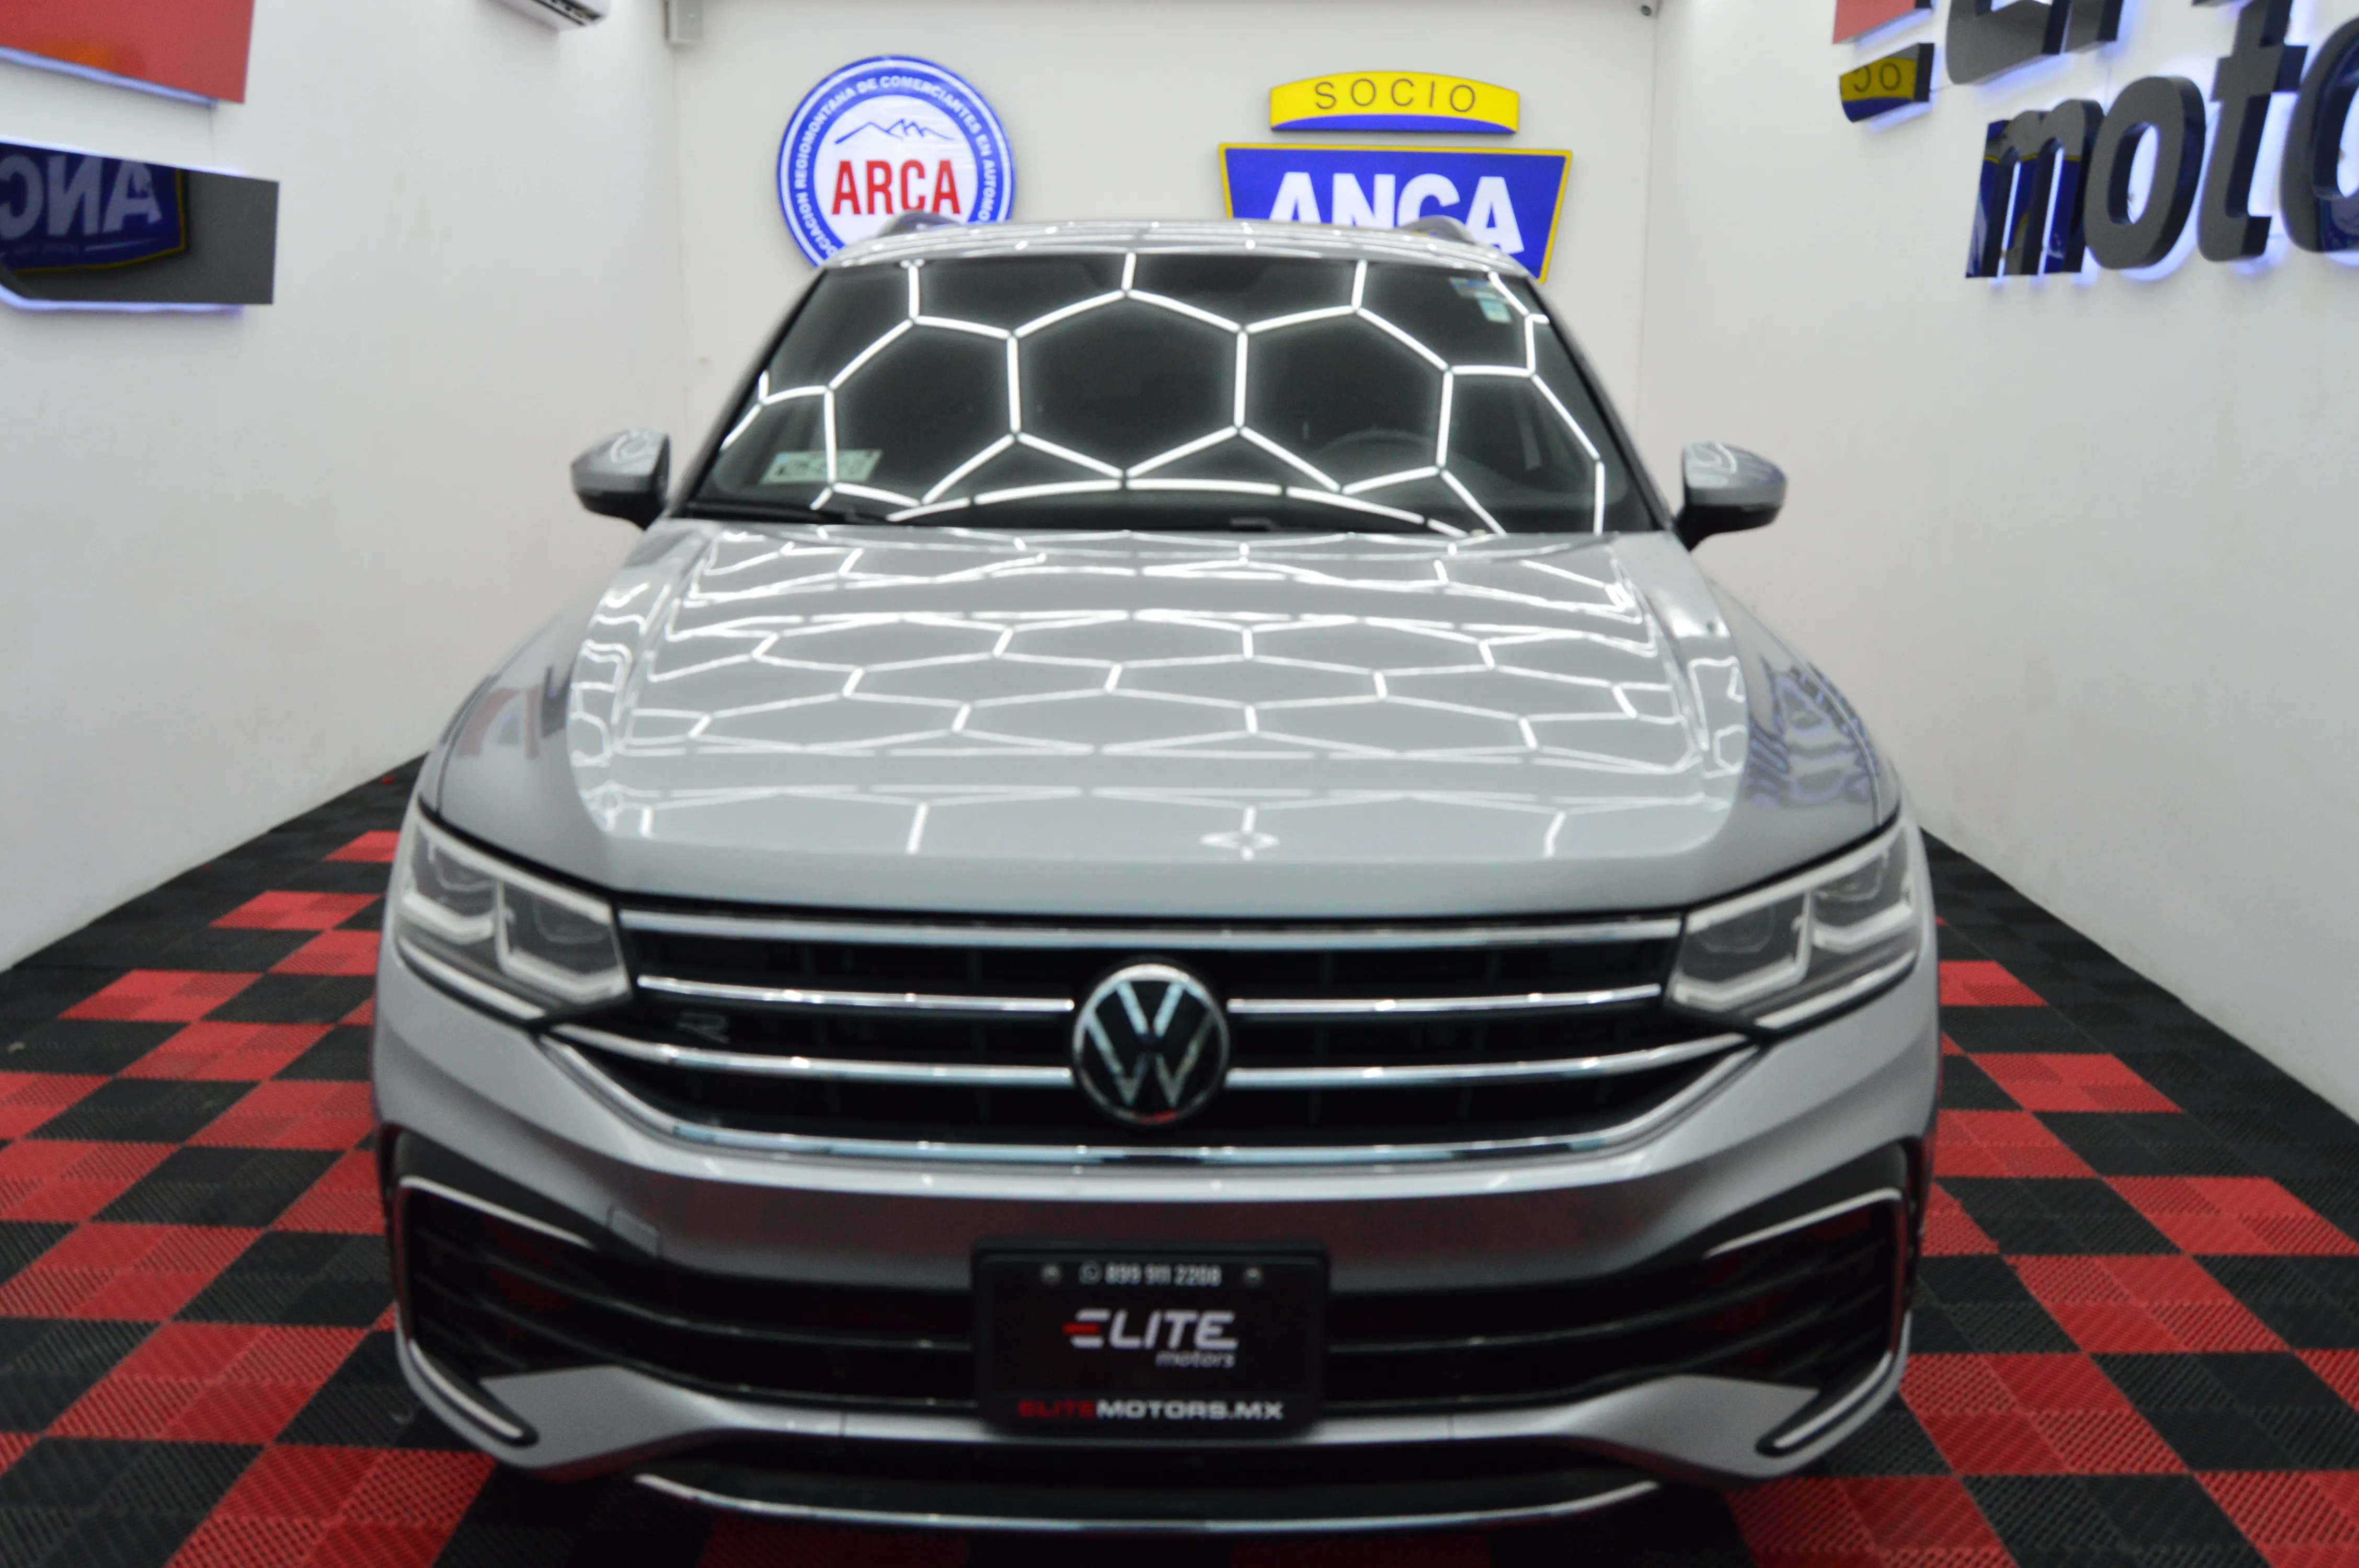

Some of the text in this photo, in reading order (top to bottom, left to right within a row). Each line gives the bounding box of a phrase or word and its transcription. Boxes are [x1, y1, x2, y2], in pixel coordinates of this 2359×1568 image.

[1314, 78, 1475, 112] SOCIO
[795, 88, 856, 189] REGIOMONTANA
[857, 77, 878, 94] DE
[879, 75, 982, 135] COMERCIANTES
[975, 134, 993, 157] EN
[831, 160, 961, 215] ARCA
[1268, 171, 1525, 255] ANCA
[1063, 1309, 1239, 1349] ELITE
[1155, 1351, 1235, 1369] motors
[1018, 1400, 1284, 1421] ELITEMOTORS.MX
